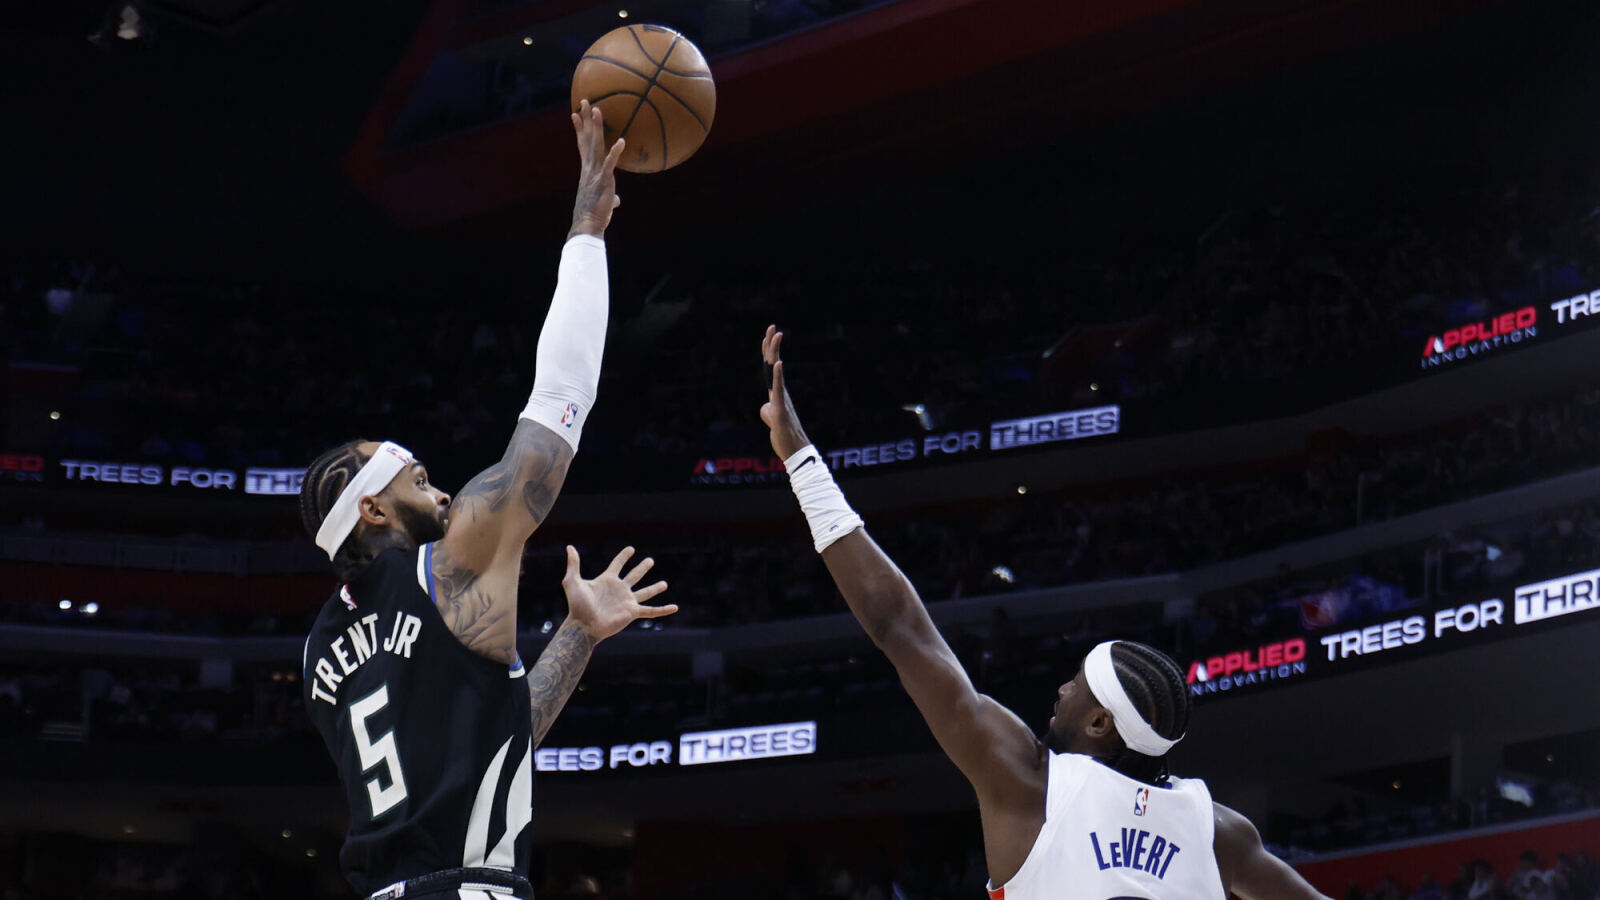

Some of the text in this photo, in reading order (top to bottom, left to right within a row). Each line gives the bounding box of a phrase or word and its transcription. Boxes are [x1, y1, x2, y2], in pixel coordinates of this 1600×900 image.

[1421, 325, 1538, 369] INNOVATION
[1423, 305, 1538, 358] APPLIED
[827, 409, 1118, 471] TREES FOR THREES
[60, 458, 163, 486] TREES
[170, 467, 237, 490] FOR
[1320, 576, 1600, 662] TREES FOR THR
[311, 610, 423, 706] TRENT JR
[1186, 637, 1307, 685] APPLIED
[1190, 660, 1308, 697] NNOVATION
[349, 681, 409, 820] 5
[534, 726, 813, 771] EES FOR THREES
